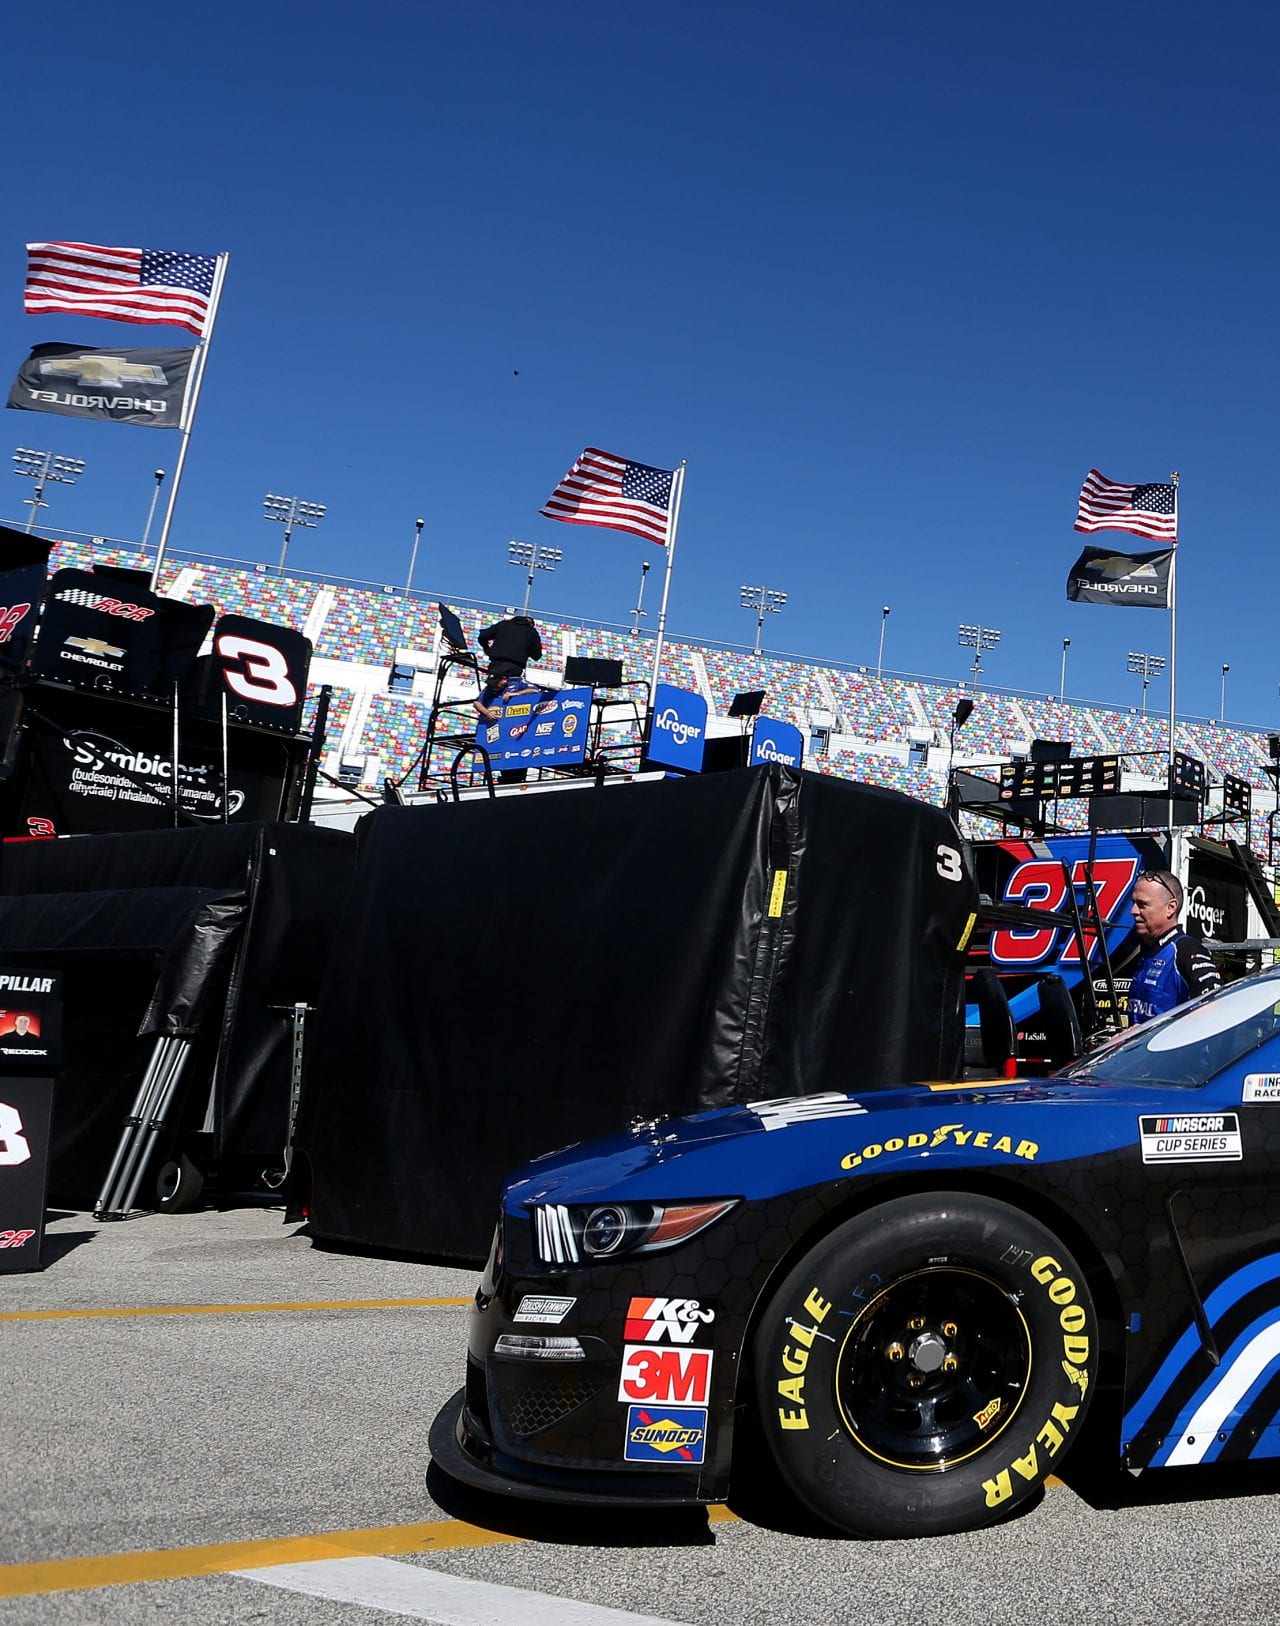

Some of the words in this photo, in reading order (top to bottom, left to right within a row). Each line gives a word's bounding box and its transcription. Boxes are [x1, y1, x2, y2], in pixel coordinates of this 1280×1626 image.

[92, 597, 156, 622] RCR
[60, 651, 125, 672] CHEVROLET
[216, 634, 297, 707] 3
[656, 708, 701, 745] Kroger
[756, 739, 796, 766] Kroger
[936, 844, 963, 882] 3
[991, 857, 1140, 963] 37
[1172, 1117, 1225, 1132] NASCAR
[1156, 1138, 1182, 1152] CUP
[1184, 1137, 1228, 1151] SERIES
[778, 1287, 833, 1431] EAGLE
[623, 1350, 709, 1402] 3M
[980, 1402, 998, 1424] AERO
[632, 1428, 701, 1443] SUNOCO
